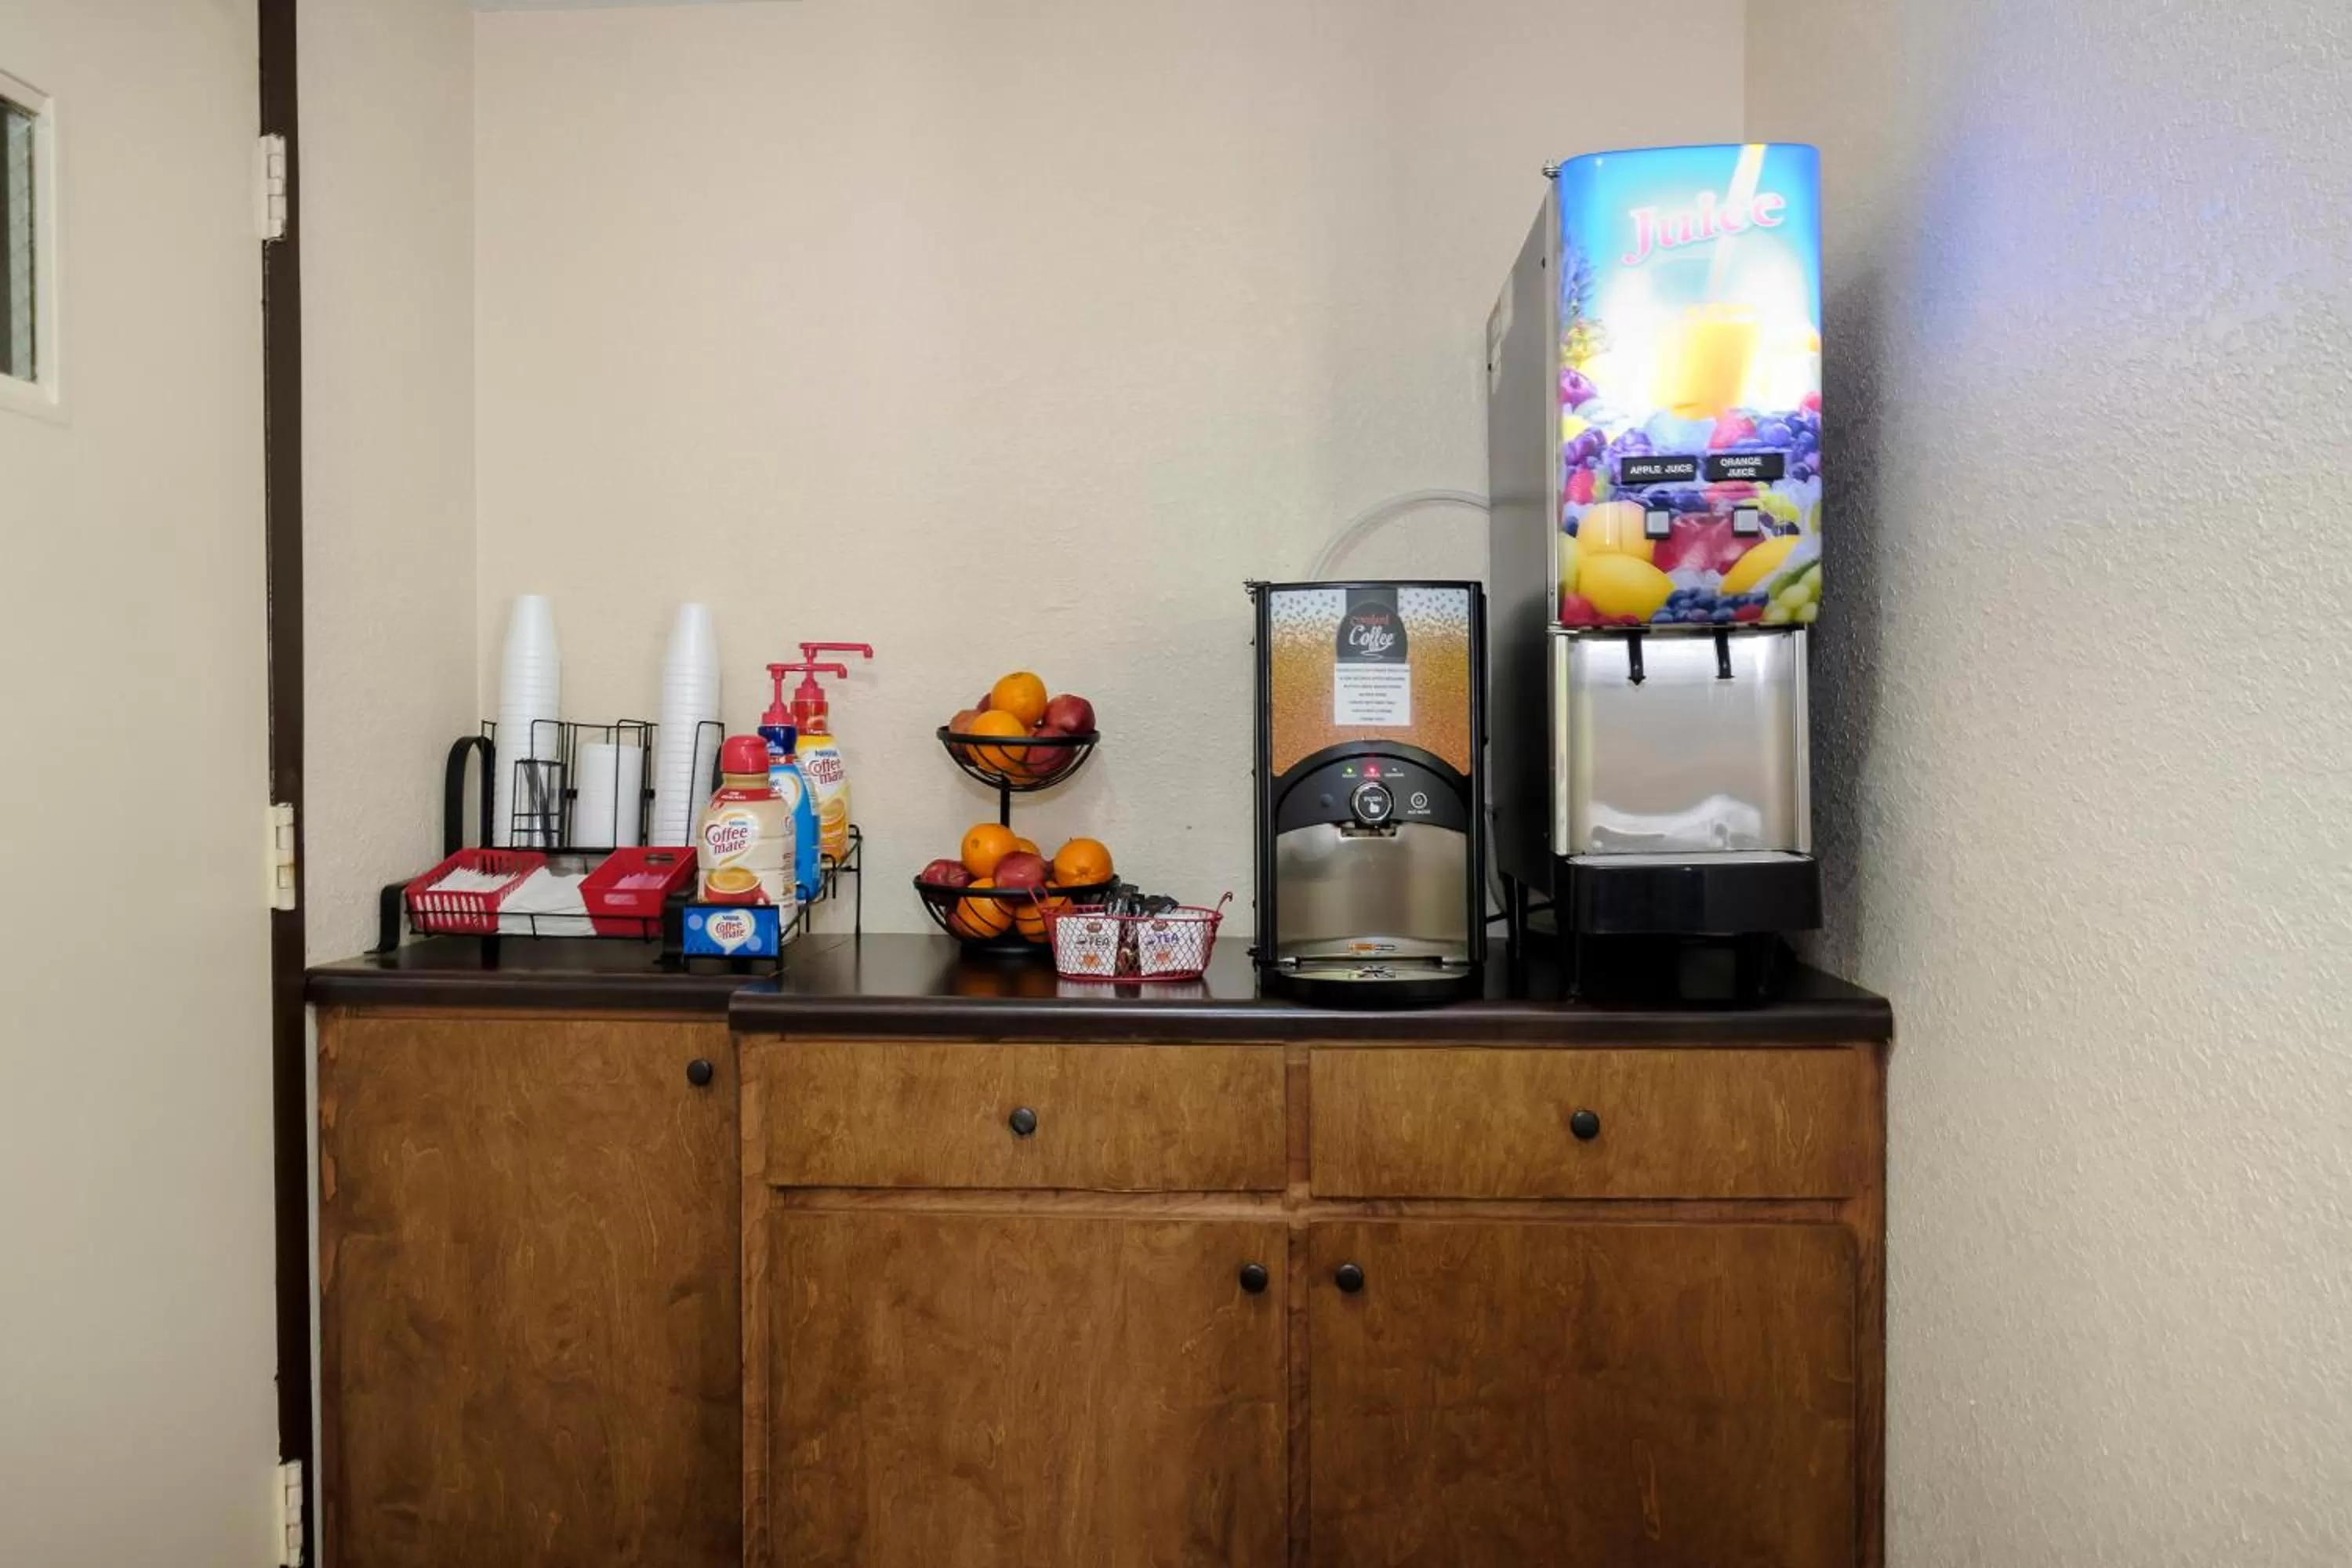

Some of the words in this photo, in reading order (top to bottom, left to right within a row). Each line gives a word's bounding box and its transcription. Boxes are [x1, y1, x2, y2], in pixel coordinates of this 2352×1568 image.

[1621, 192, 1785, 264] Juice
[1719, 456, 1762, 466] ORANGE
[1630, 465, 1662, 474] APPLE
[1664, 463, 1693, 474] JUICE
[1727, 467, 1756, 477] JUICE
[1348, 625, 1394, 652] Coffee
[808, 758, 840, 776] Coffee
[705, 824, 748, 846] Coffee
[714, 840, 746, 854] mate
[715, 921, 742, 934] Coffee
[1088, 937, 1109, 946] TEA
[1156, 932, 1178, 943] TEA
